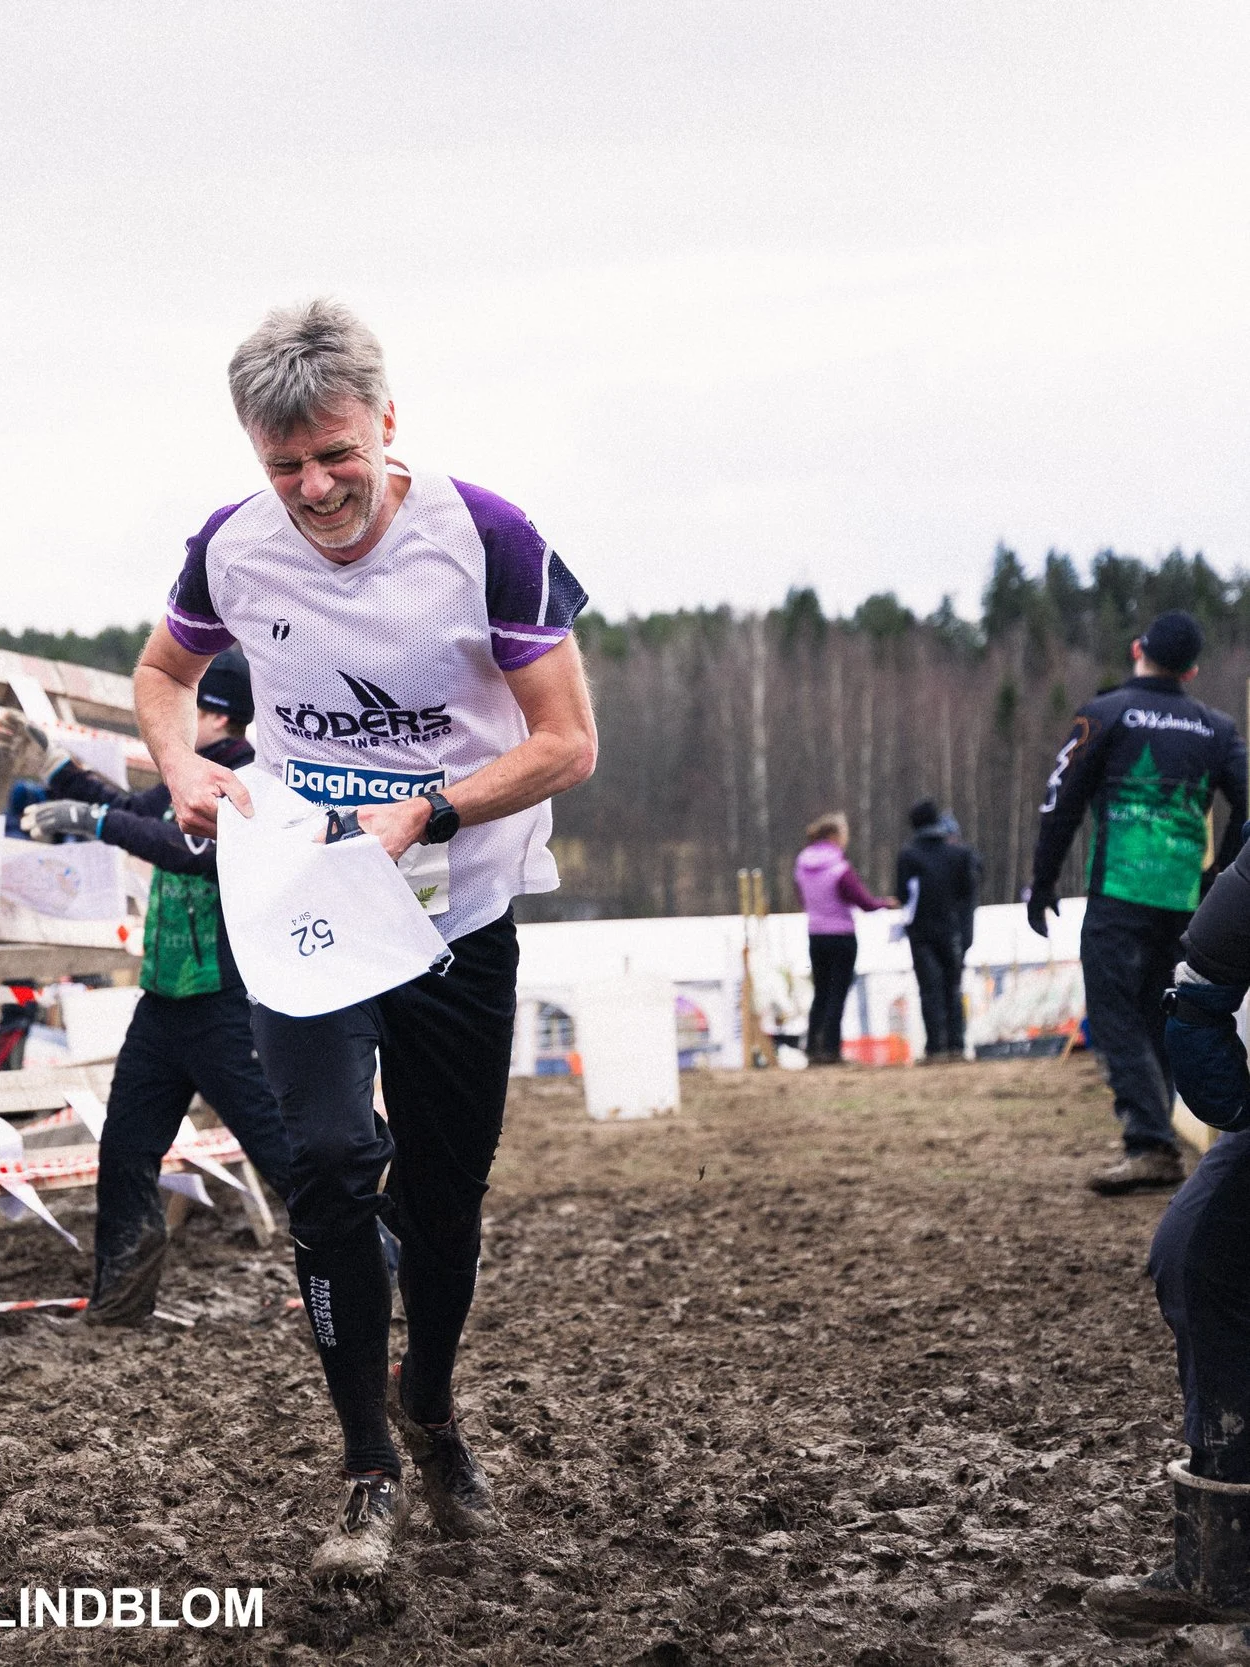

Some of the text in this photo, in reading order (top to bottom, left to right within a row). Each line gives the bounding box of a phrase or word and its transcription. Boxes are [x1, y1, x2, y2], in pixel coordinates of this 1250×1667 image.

[275, 703, 452, 738] SÖDERS
[287, 763, 444, 800] bagheera
[291, 919, 334, 956] 52
[310, 1275, 337, 1347] noname
